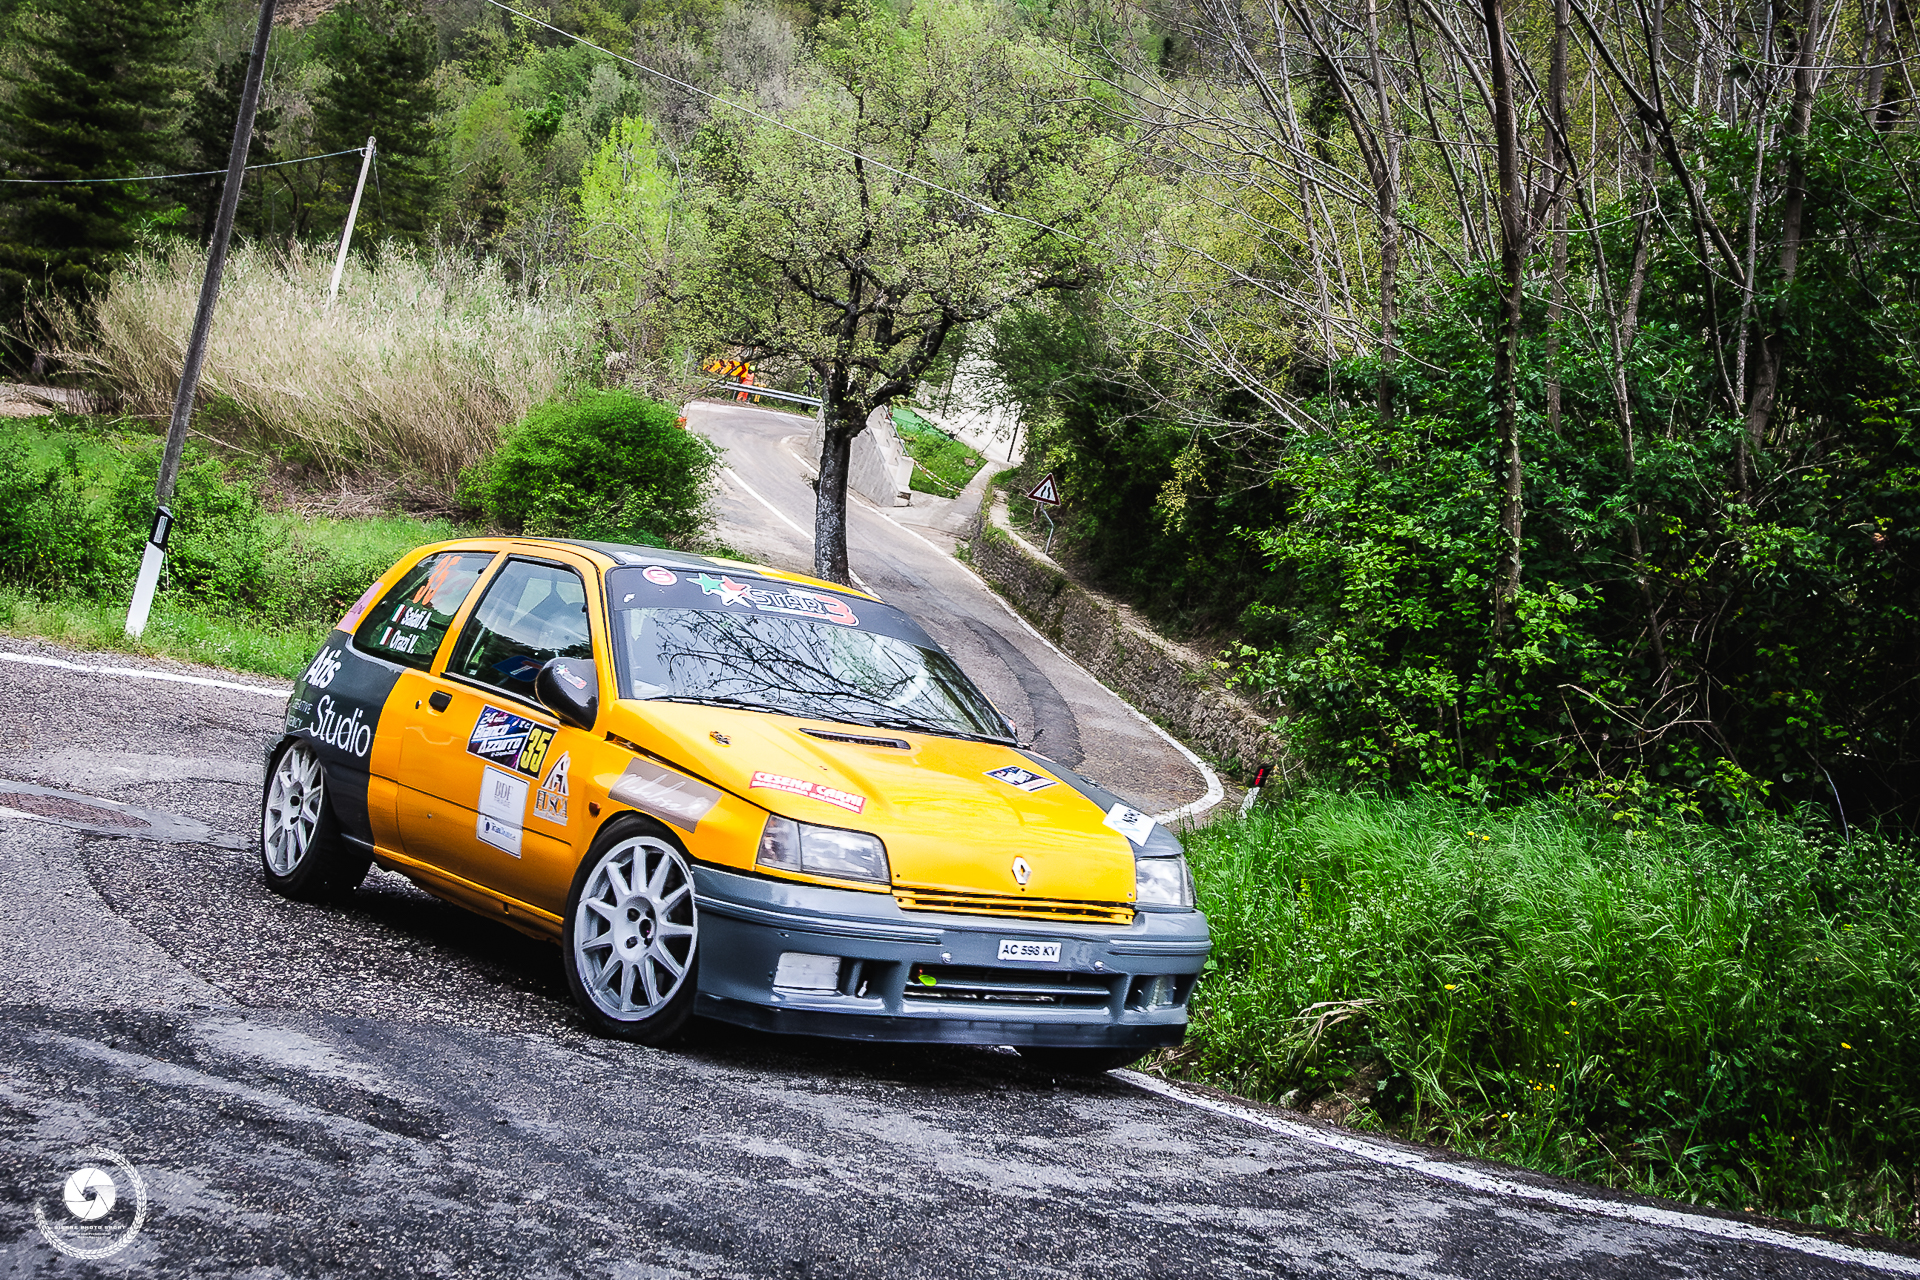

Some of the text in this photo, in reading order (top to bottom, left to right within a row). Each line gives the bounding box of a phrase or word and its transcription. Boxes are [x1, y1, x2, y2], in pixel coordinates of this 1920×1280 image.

[310, 694, 371, 758] Studio
[520, 728, 553, 773] 35
[754, 772, 864, 808] CESENA CARNI
[1002, 944, 1018, 955] AC
